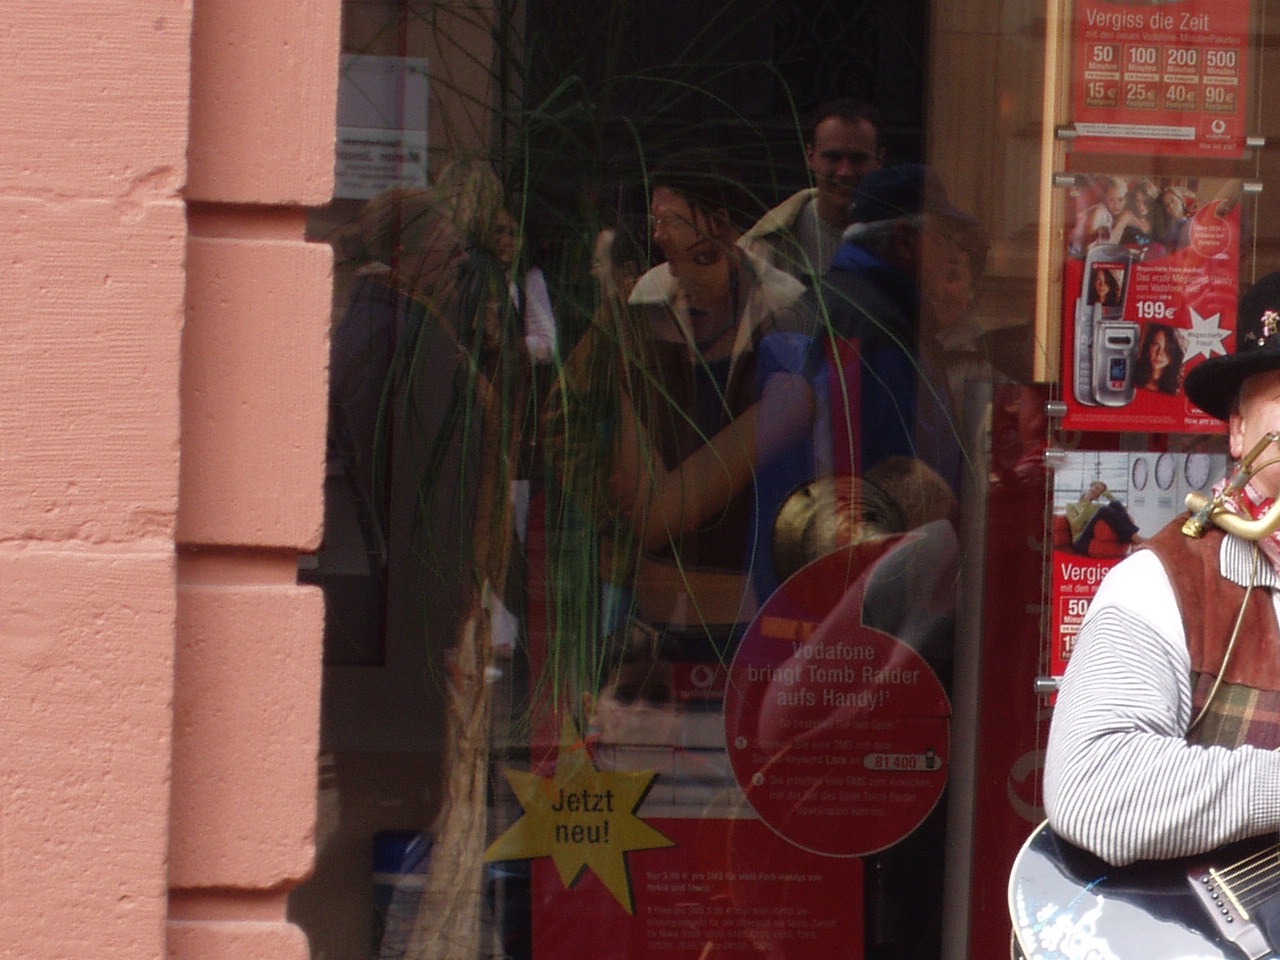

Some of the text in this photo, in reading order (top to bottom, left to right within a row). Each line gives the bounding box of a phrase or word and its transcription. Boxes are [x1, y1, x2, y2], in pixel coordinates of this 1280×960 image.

[1087, 8, 1209, 31] Vergiss die Zeit
[1093, 46, 1113, 62] 50
[1129, 47, 1156, 64] 100
[1168, 49, 1197, 65] 200
[1207, 51, 1236, 67] 500
[1088, 82, 1104, 98] 15
[1074, 584, 1090, 592] den
[1069, 599, 1088, 615] 50
[793, 641, 875, 660] Vodafone
[748, 664, 919, 686] bringt Tomb Raider
[776, 689, 815, 707] aufs
[552, 788, 614, 813] Jetzt
[556, 820, 610, 843] neu!
